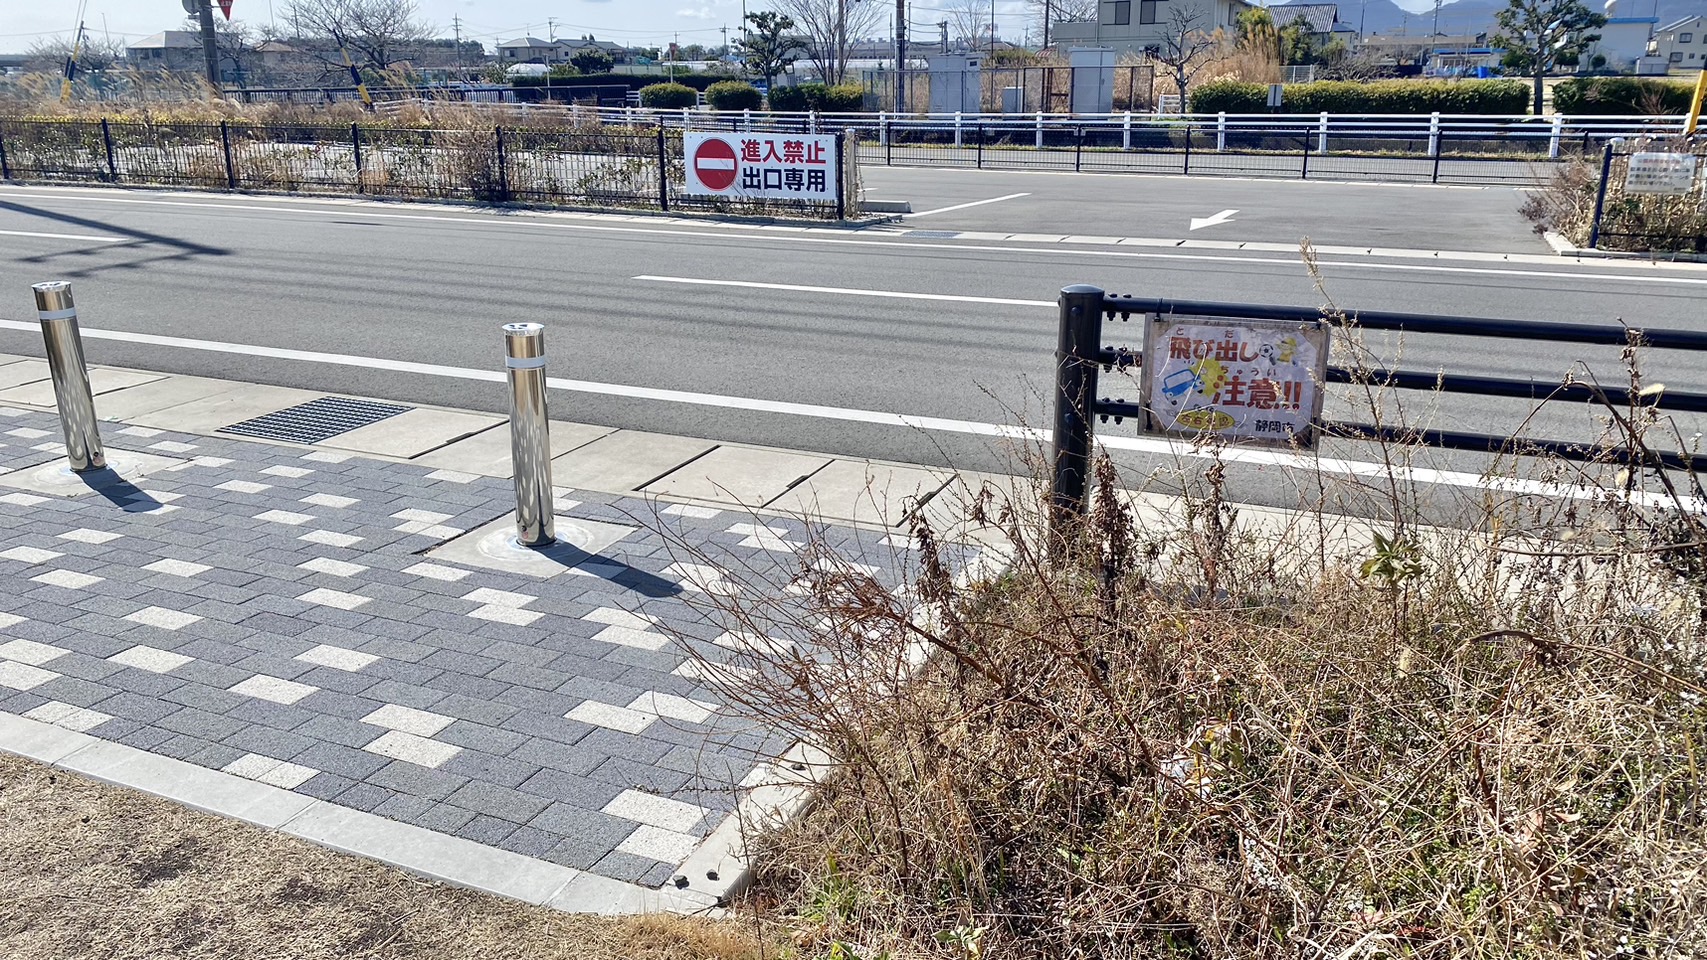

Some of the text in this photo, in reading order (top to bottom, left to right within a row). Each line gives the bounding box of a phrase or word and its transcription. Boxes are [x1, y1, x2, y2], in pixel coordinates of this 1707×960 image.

[741, 139, 826, 164] 進入禁止
[742, 166, 826, 192] 出口専用
[1176, 327, 1234, 339] と だ
[1170, 336, 1260, 362] 飛び出し
